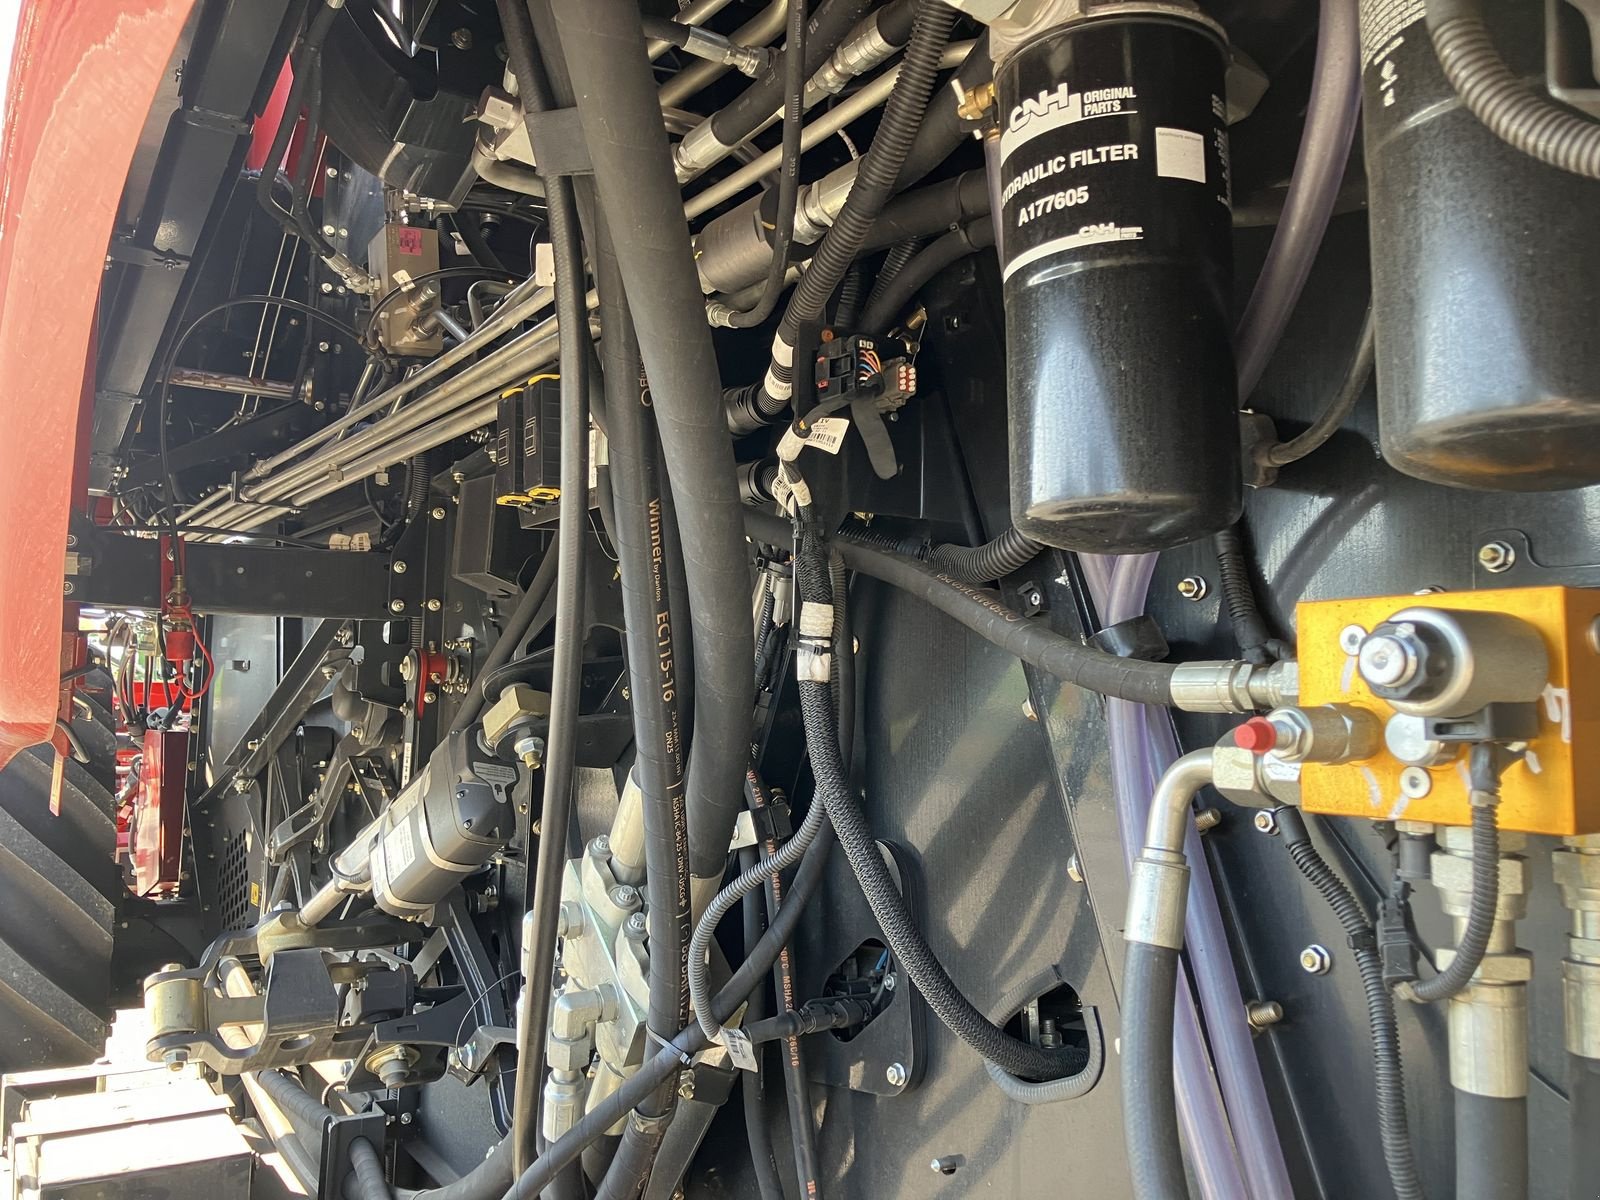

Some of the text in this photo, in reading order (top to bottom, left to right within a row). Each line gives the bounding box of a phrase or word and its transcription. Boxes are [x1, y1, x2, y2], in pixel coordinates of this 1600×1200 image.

[1010, 82, 1069, 133] CNH
[1083, 87, 1137, 104] ORIGINAL
[1084, 100, 1121, 116] PARTS
[1069, 143, 1139, 169] FILTER
[1018, 185, 1090, 227] A177605
[648, 498, 663, 563] Winner
[653, 574, 663, 602] Danfoss
[656, 611, 677, 702] EC115-16
[665, 731, 674, 754] DN25
[747, 770, 764, 803] WP 210
[677, 857, 685, 874] DNV
[678, 877, 687, 899] USCG
[782, 975, 793, 1002] MSHA
